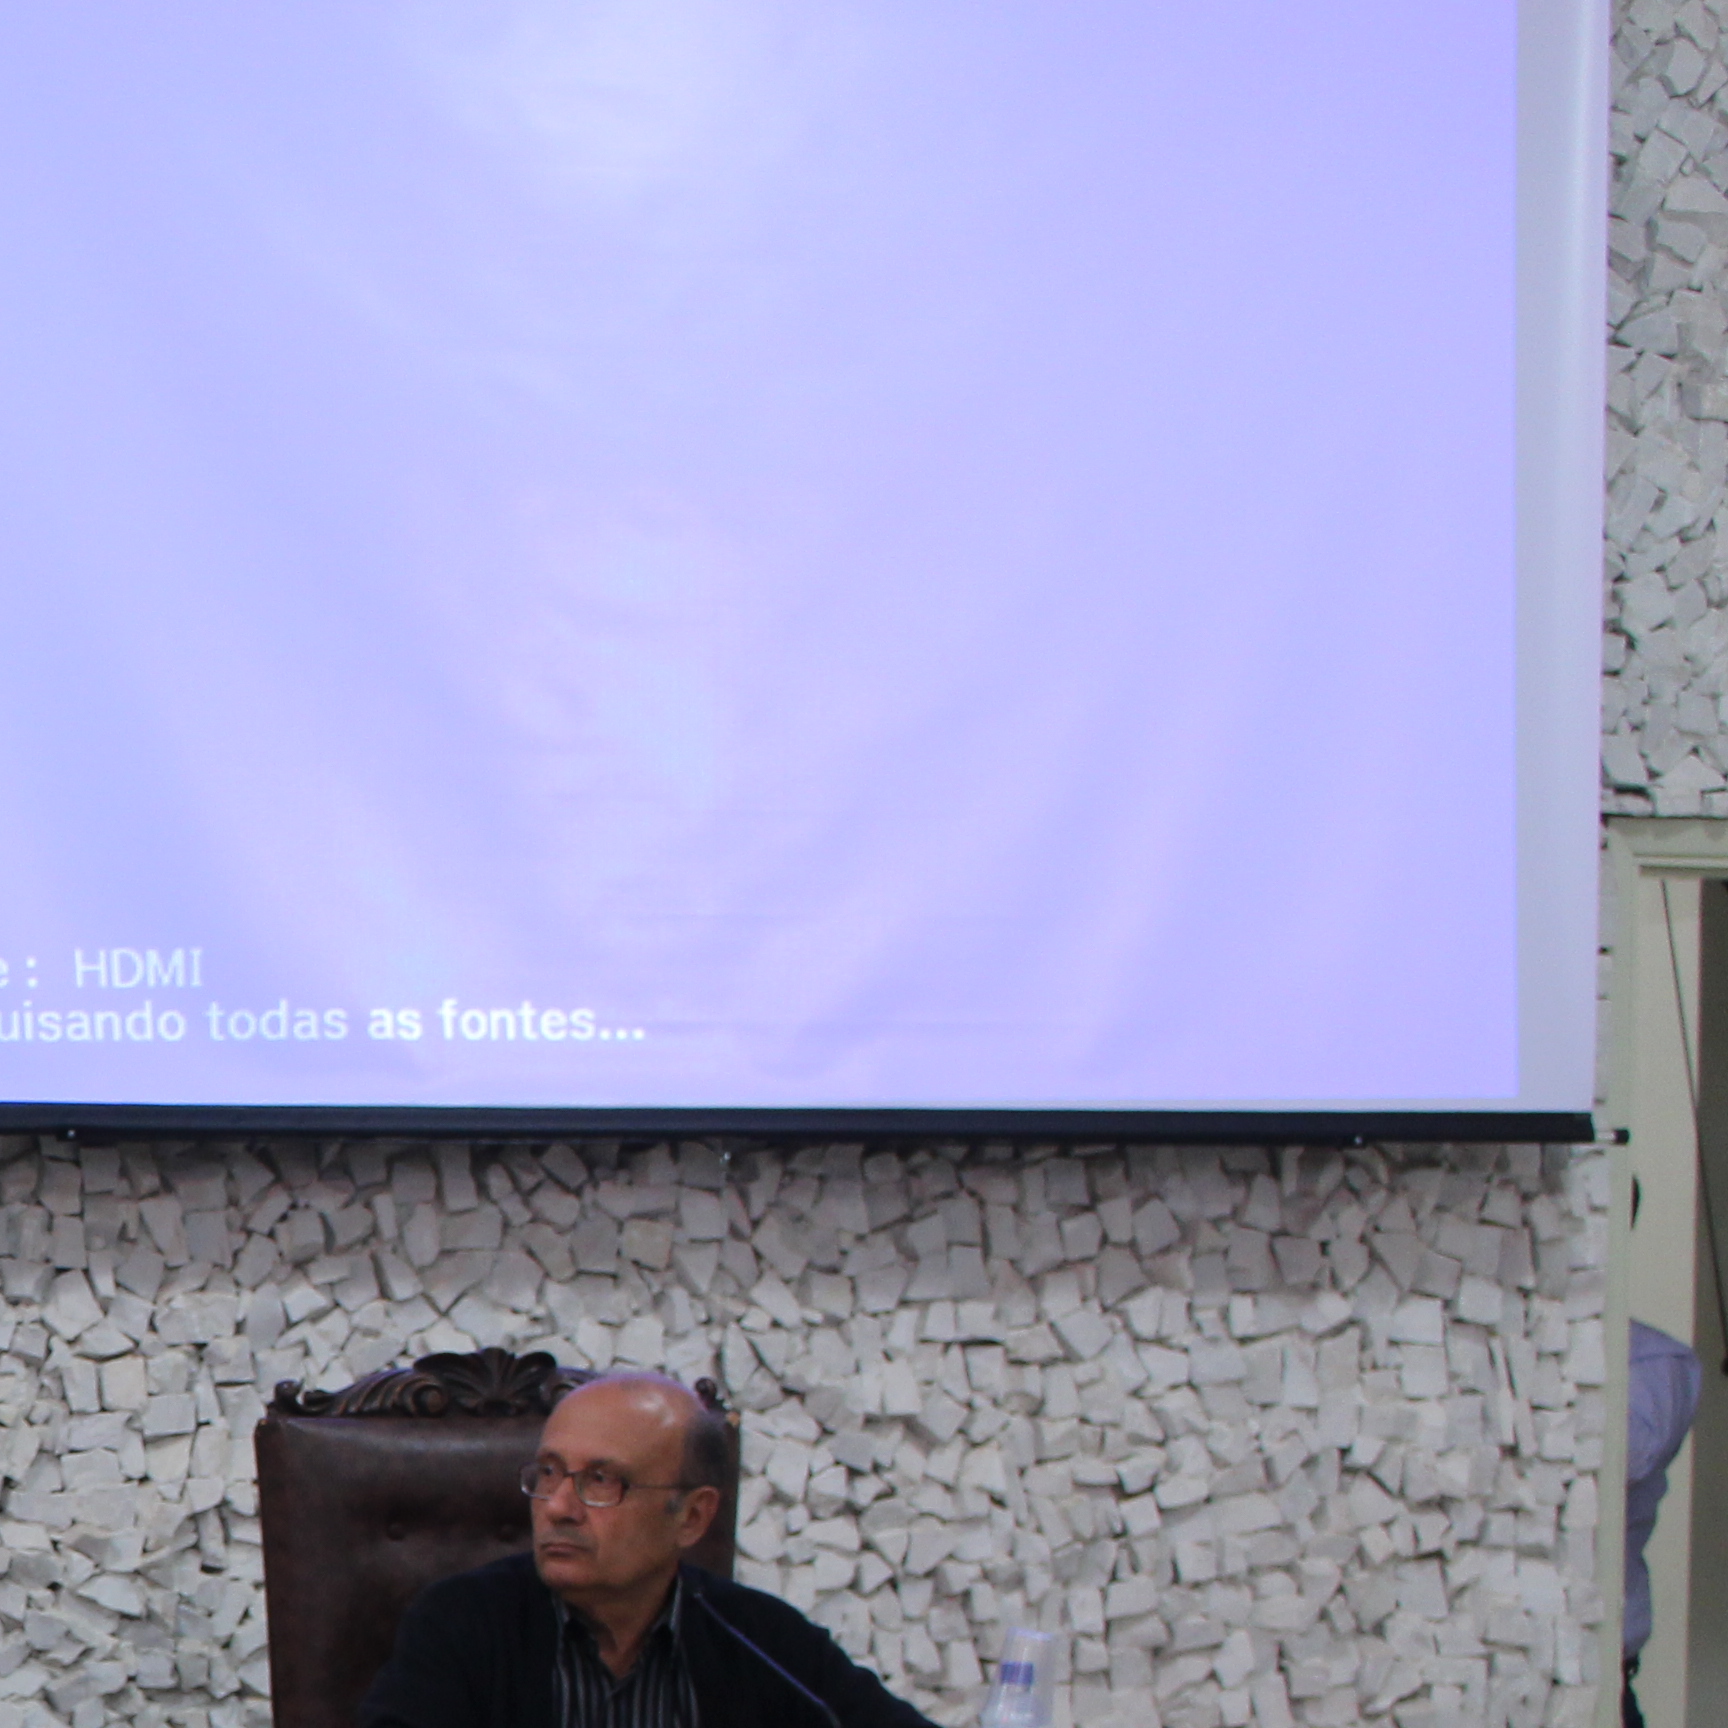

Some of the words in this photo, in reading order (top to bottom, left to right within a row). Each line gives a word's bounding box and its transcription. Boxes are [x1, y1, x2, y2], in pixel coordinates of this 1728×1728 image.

[74, 948, 204, 989] HDMI
[206, 999, 348, 1042] todas
[367, 1006, 423, 1042] as
[438, 997, 645, 1042] fontes...
